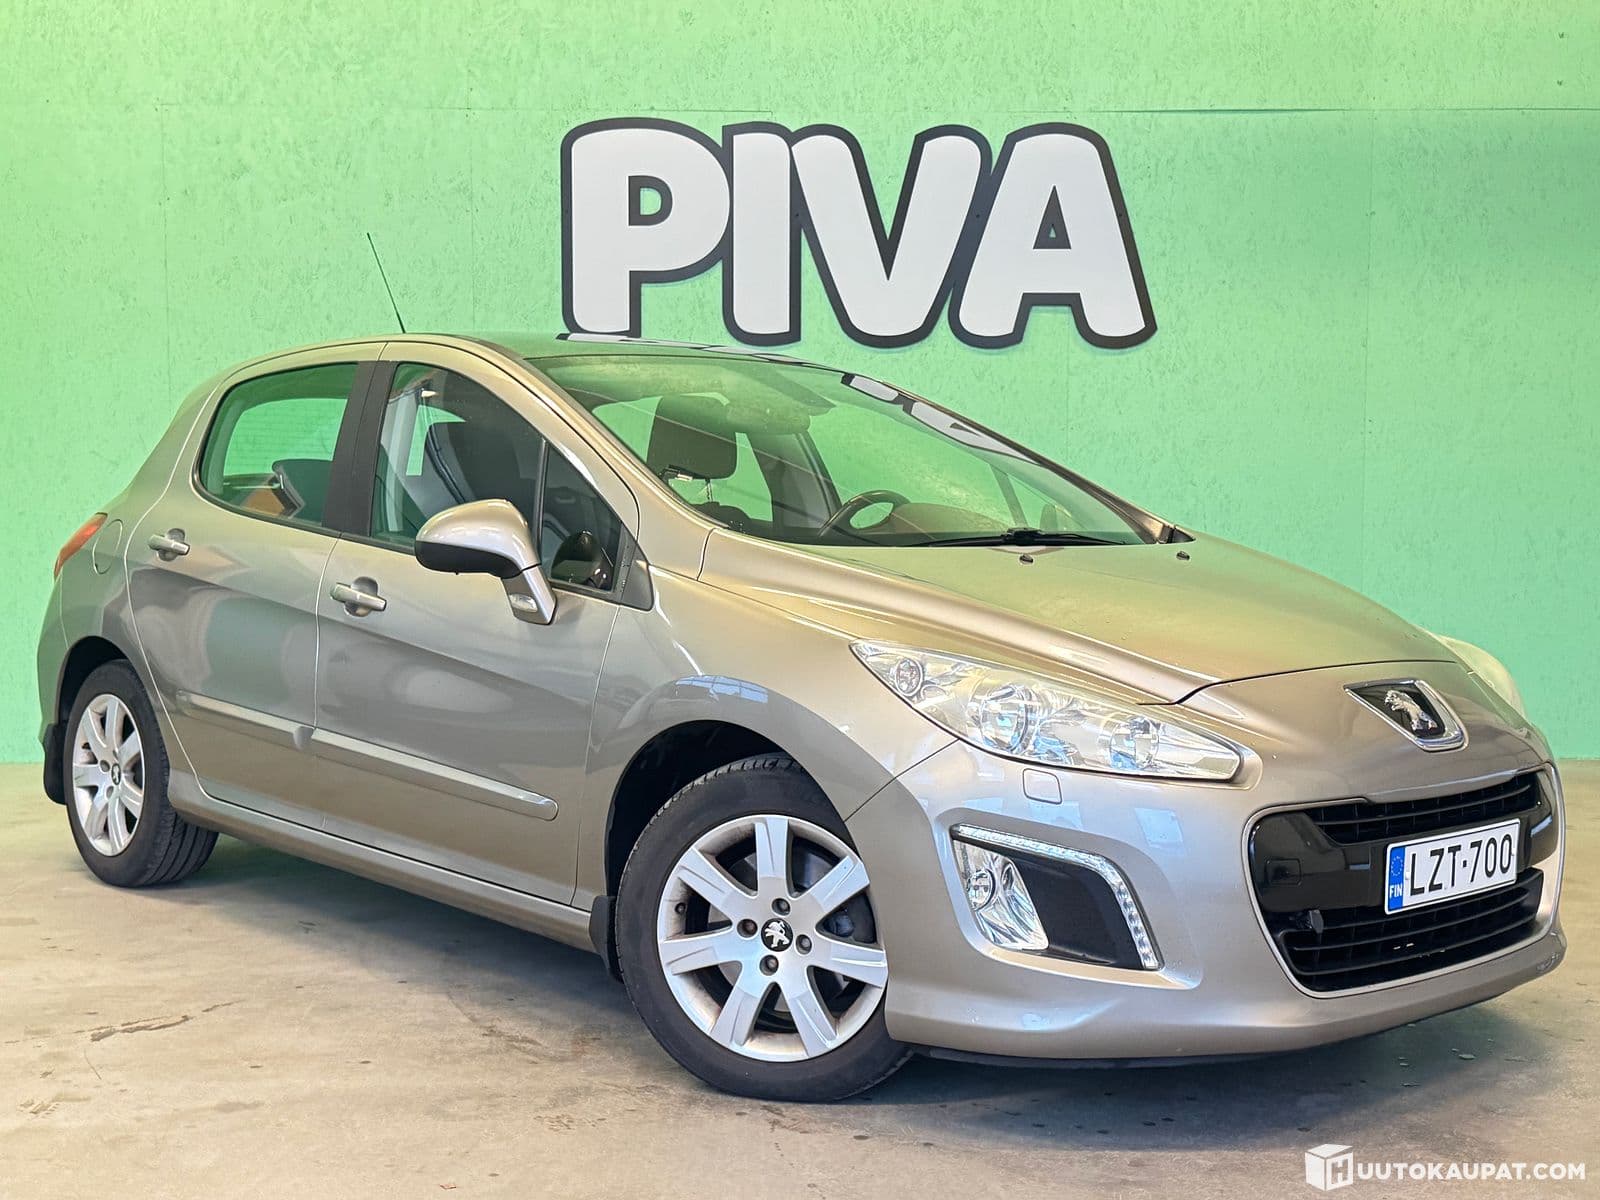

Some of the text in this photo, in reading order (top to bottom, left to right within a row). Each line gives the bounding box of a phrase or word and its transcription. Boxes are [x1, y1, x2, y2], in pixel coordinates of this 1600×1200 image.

[560, 117, 1157, 349] PIVA
[1389, 883, 1403, 899] FIN
[1410, 833, 1513, 897] LZT-700
